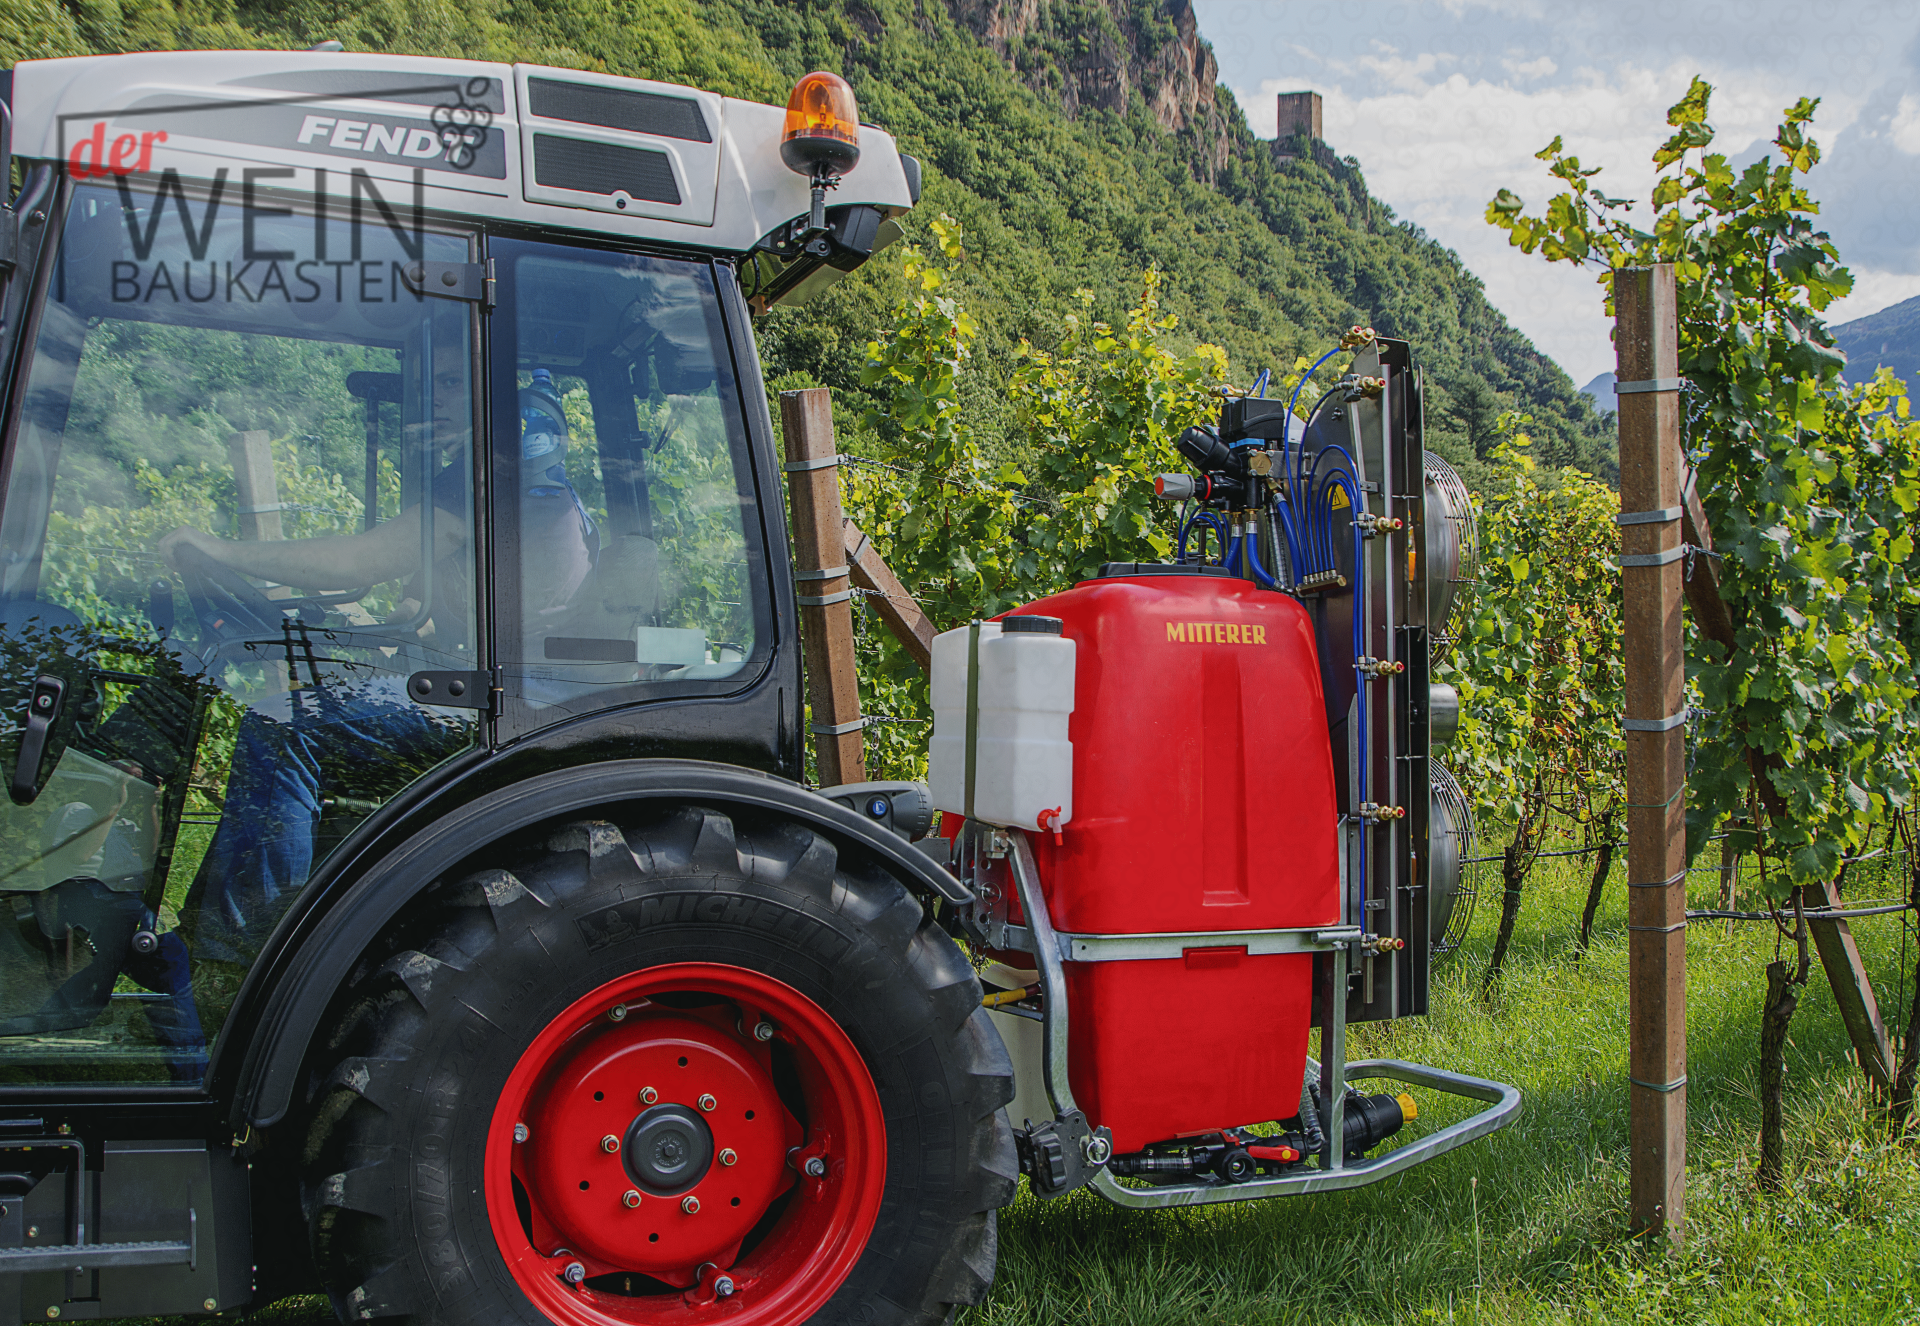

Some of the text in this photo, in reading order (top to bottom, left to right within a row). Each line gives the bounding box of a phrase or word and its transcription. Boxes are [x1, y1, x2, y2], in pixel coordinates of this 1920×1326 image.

[297, 115, 475, 163] FENDT
[1166, 622, 1267, 644] MITTERER
[640, 895, 850, 961] MICHELIN
